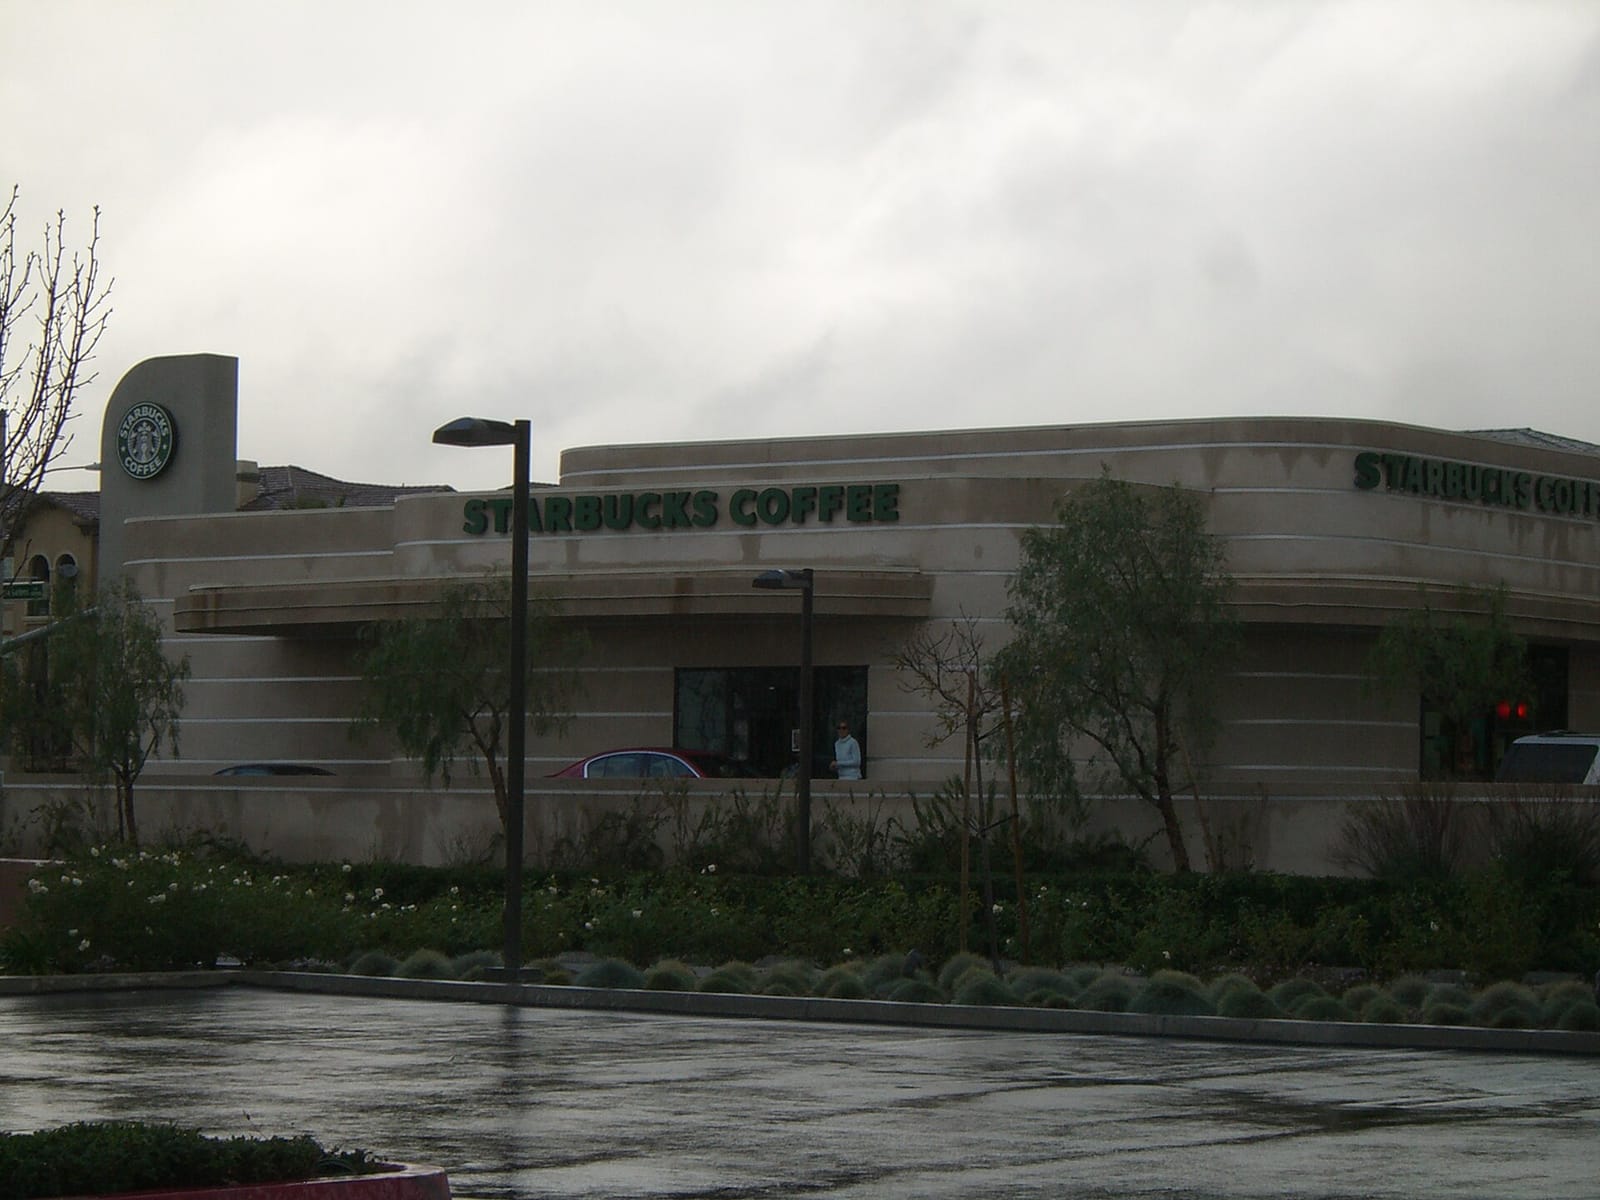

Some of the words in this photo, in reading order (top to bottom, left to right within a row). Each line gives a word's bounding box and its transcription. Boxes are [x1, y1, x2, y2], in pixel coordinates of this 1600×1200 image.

[120, 406, 169, 439] STARBUCKS
[124, 456, 162, 475] COFFEE
[1354, 451, 1532, 510] STARBUCKS
[729, 483, 900, 527] COFFEE
